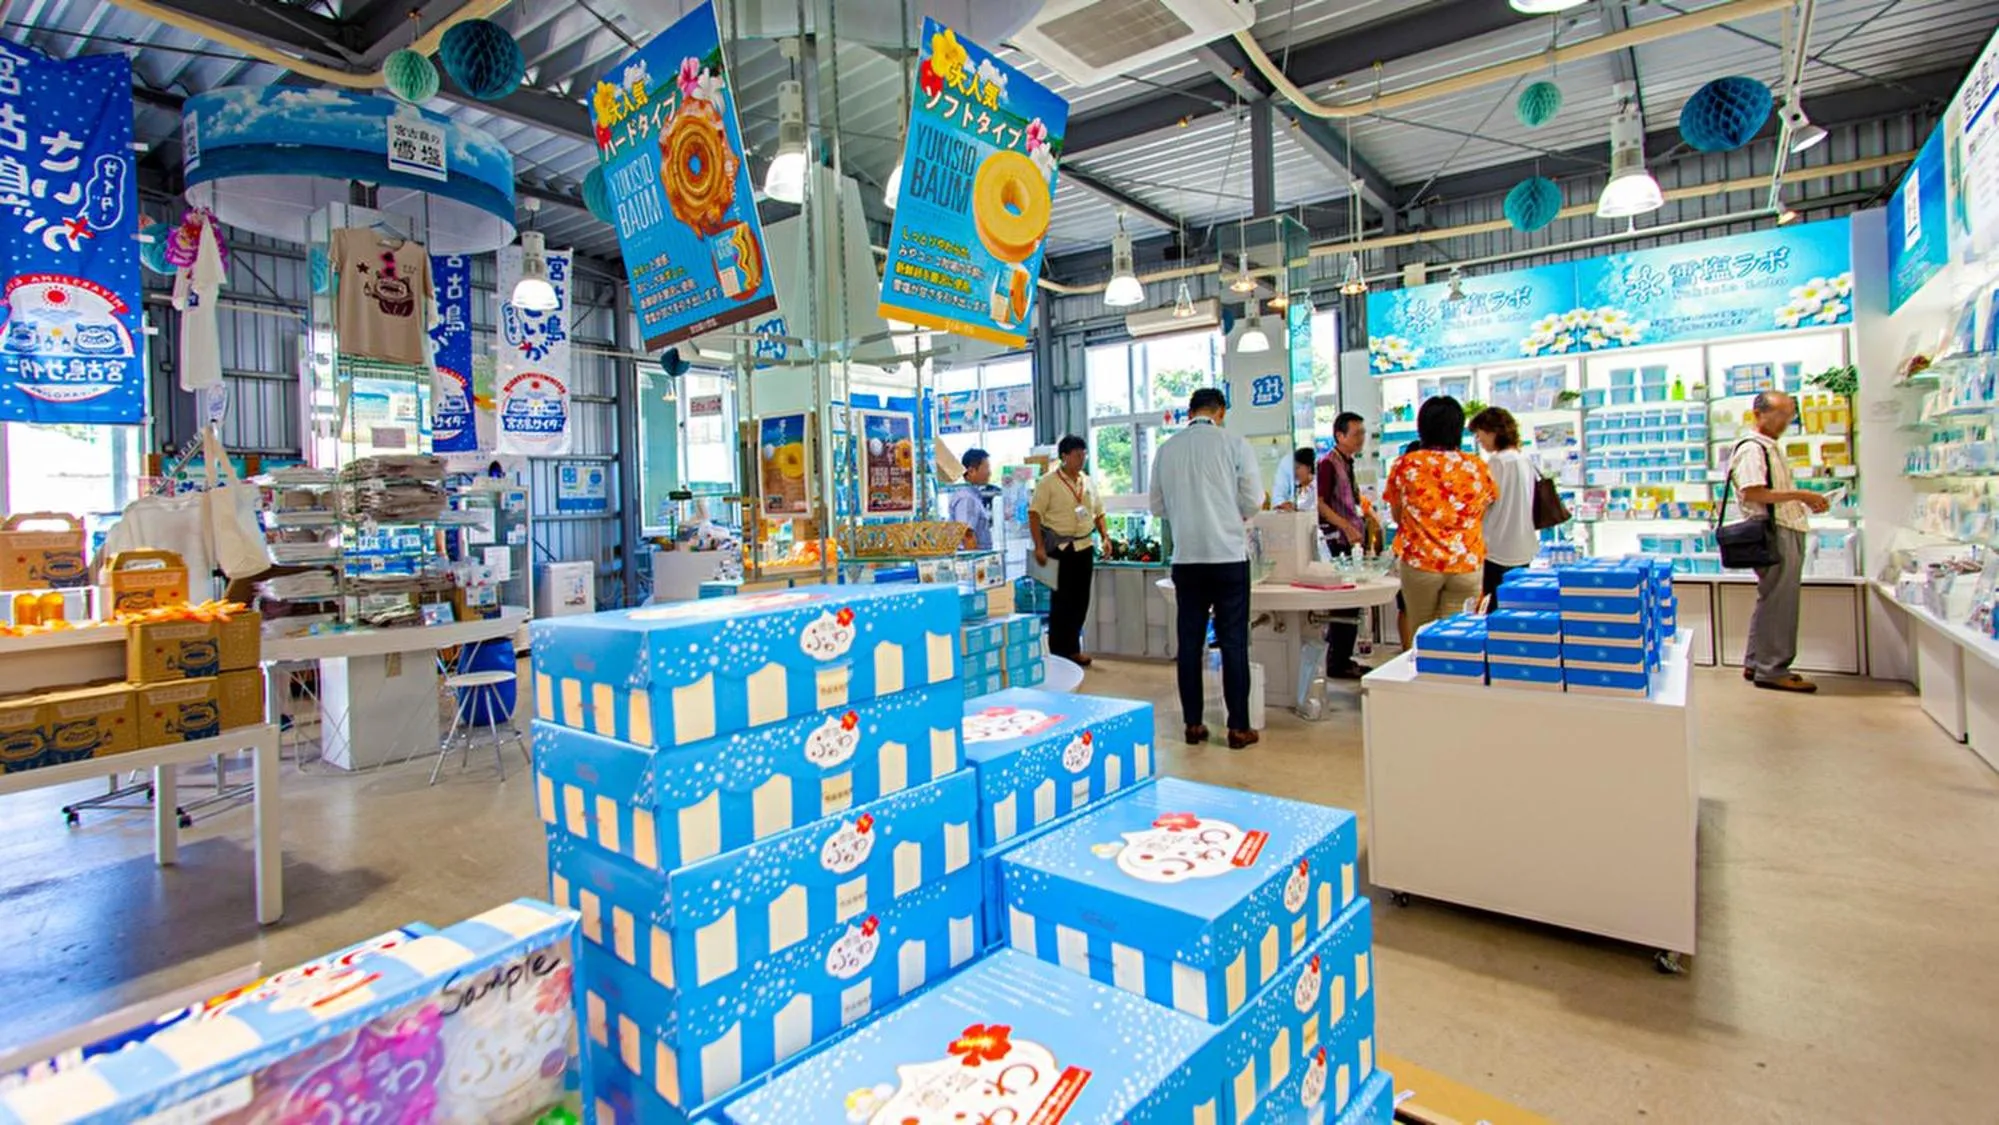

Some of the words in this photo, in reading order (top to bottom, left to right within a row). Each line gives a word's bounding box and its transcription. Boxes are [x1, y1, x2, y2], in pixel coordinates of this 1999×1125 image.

[609, 80, 648, 127] 大人気
[949, 63, 1000, 111] 大人気
[394, 124, 440, 145] 宮古島の
[604, 92, 676, 162] ハードタイプ
[926, 85, 1022, 150] ソフトタイプ
[393, 139, 442, 168] 雪塩
[914, 122, 977, 177] YUKISIO
[617, 184, 663, 239] BAUM
[909, 157, 972, 216] BAUM
[505, 416, 563, 432] 宮古島サイダー
[439, 950, 561, 1016] Sample
